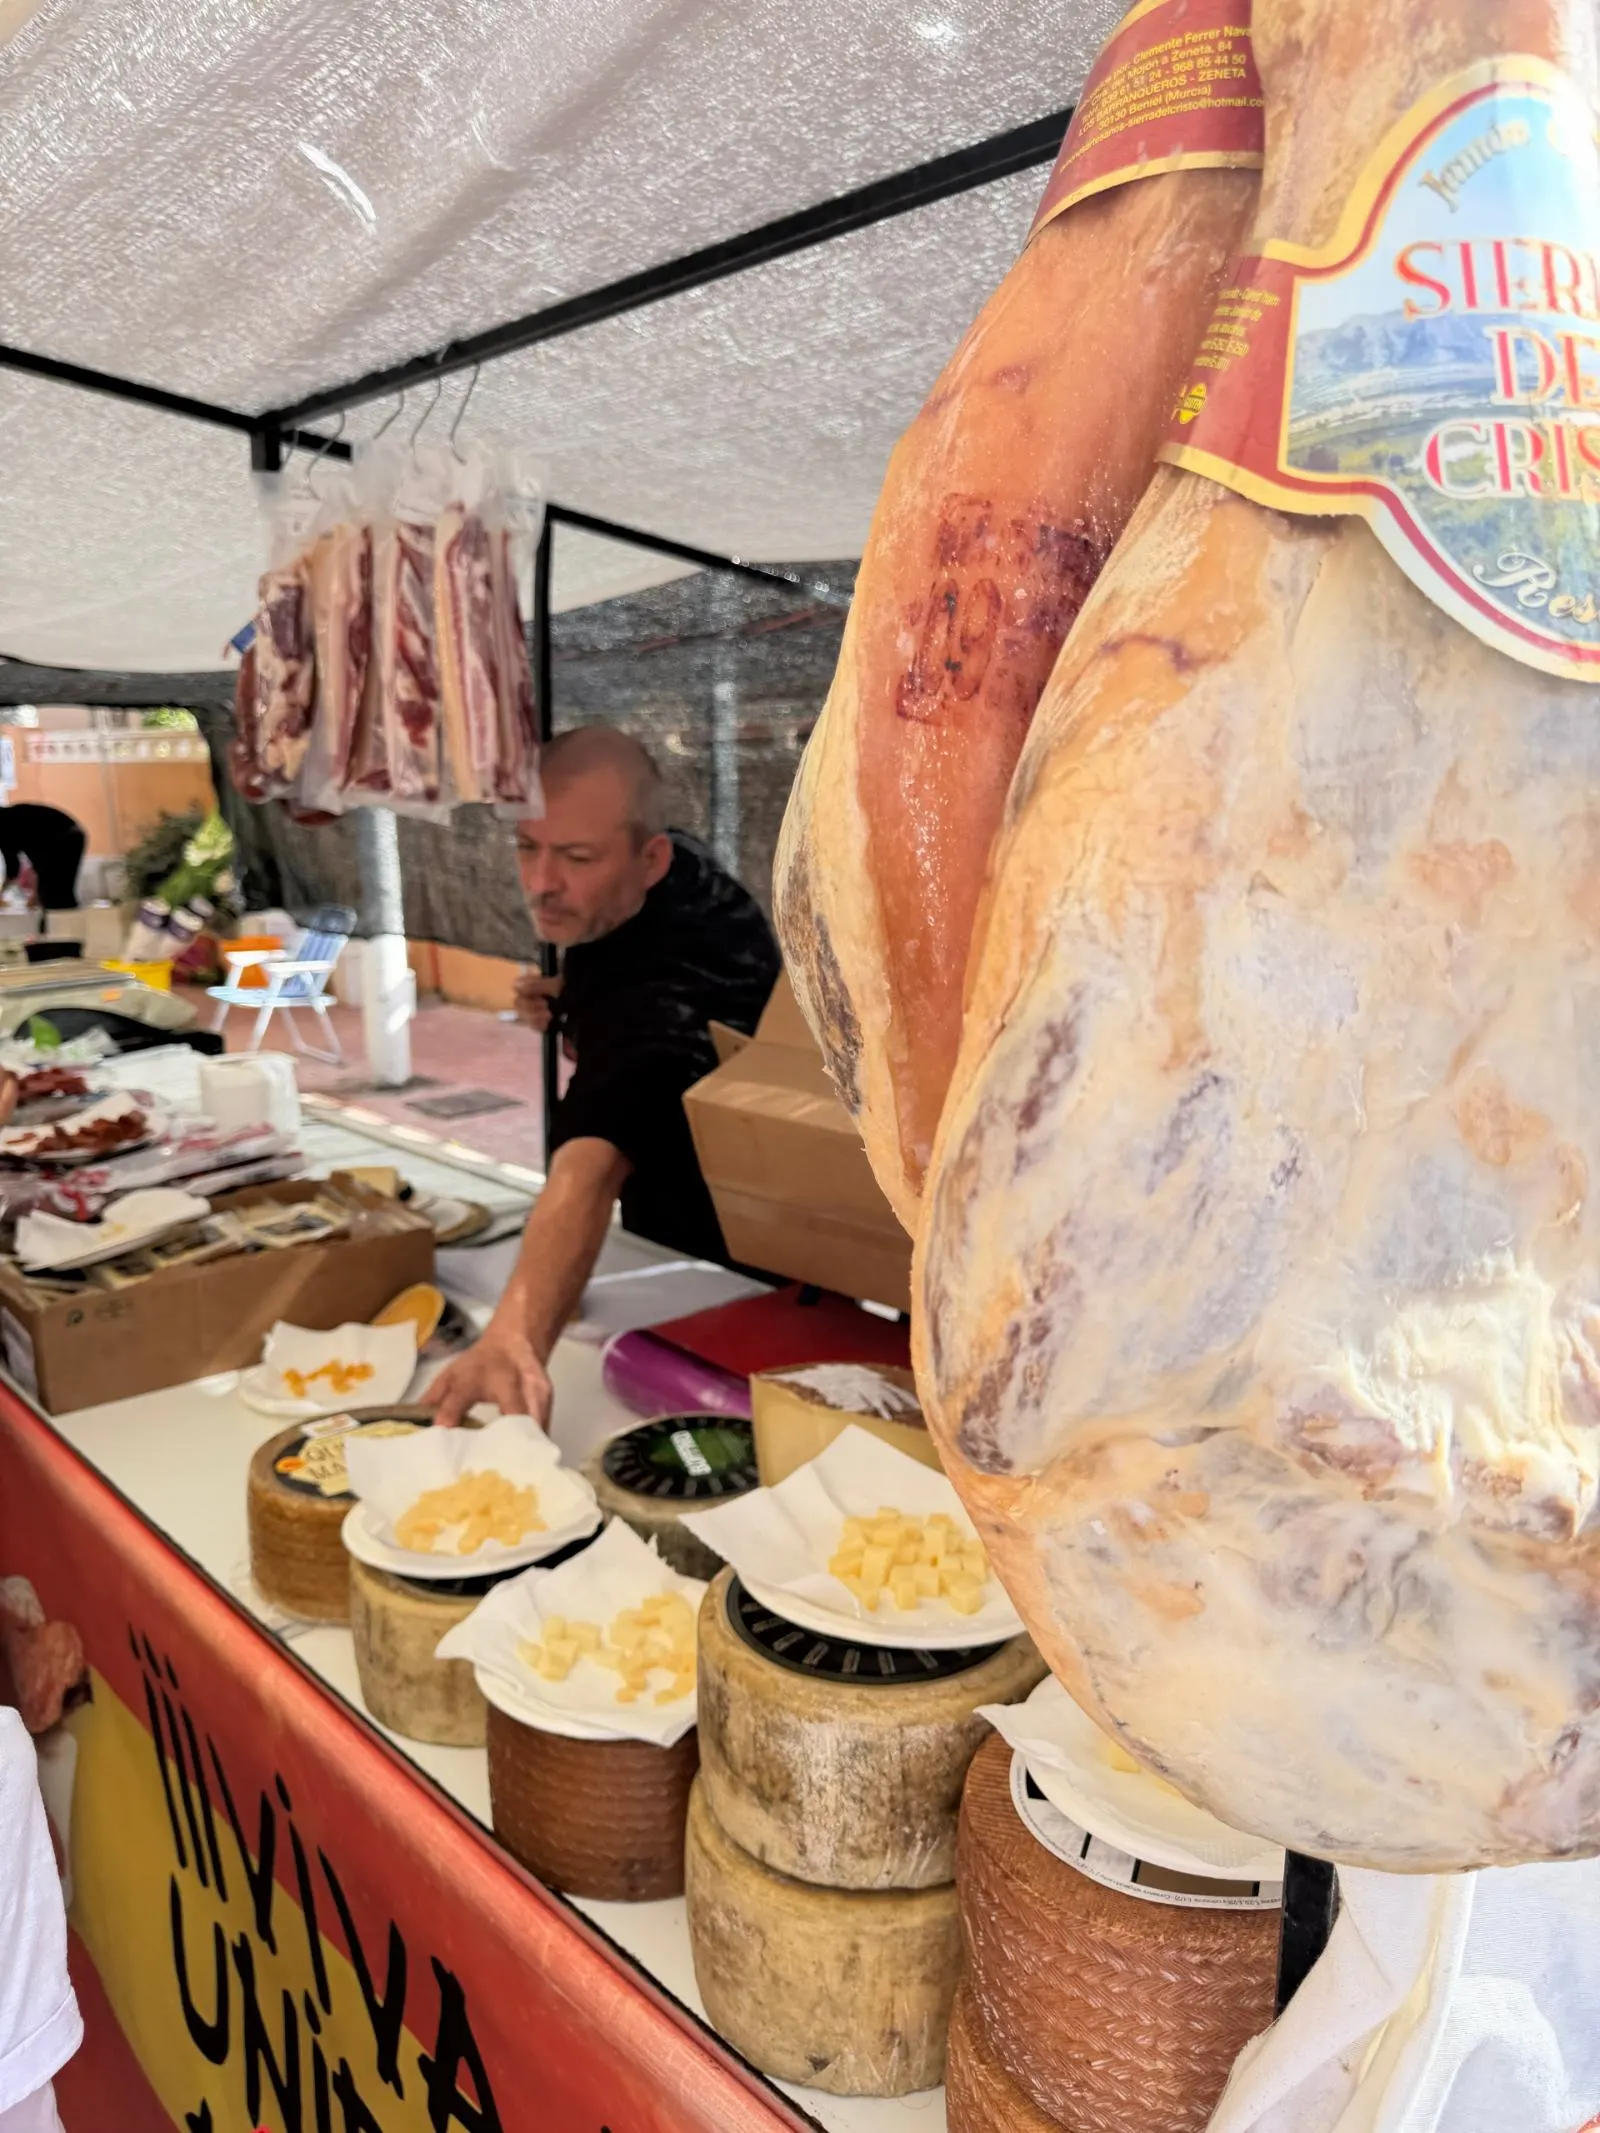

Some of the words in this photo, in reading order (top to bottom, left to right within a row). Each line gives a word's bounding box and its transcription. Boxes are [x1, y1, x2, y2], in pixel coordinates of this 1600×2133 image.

[1133, 38, 1182, 64] Clemente
[1184, 29, 1220, 47] Ferrer
[1172, 60, 1194, 73] 968
[1198, 68, 1246, 82] ZENETA
[1165, 84, 1212, 104] (Murcia)
